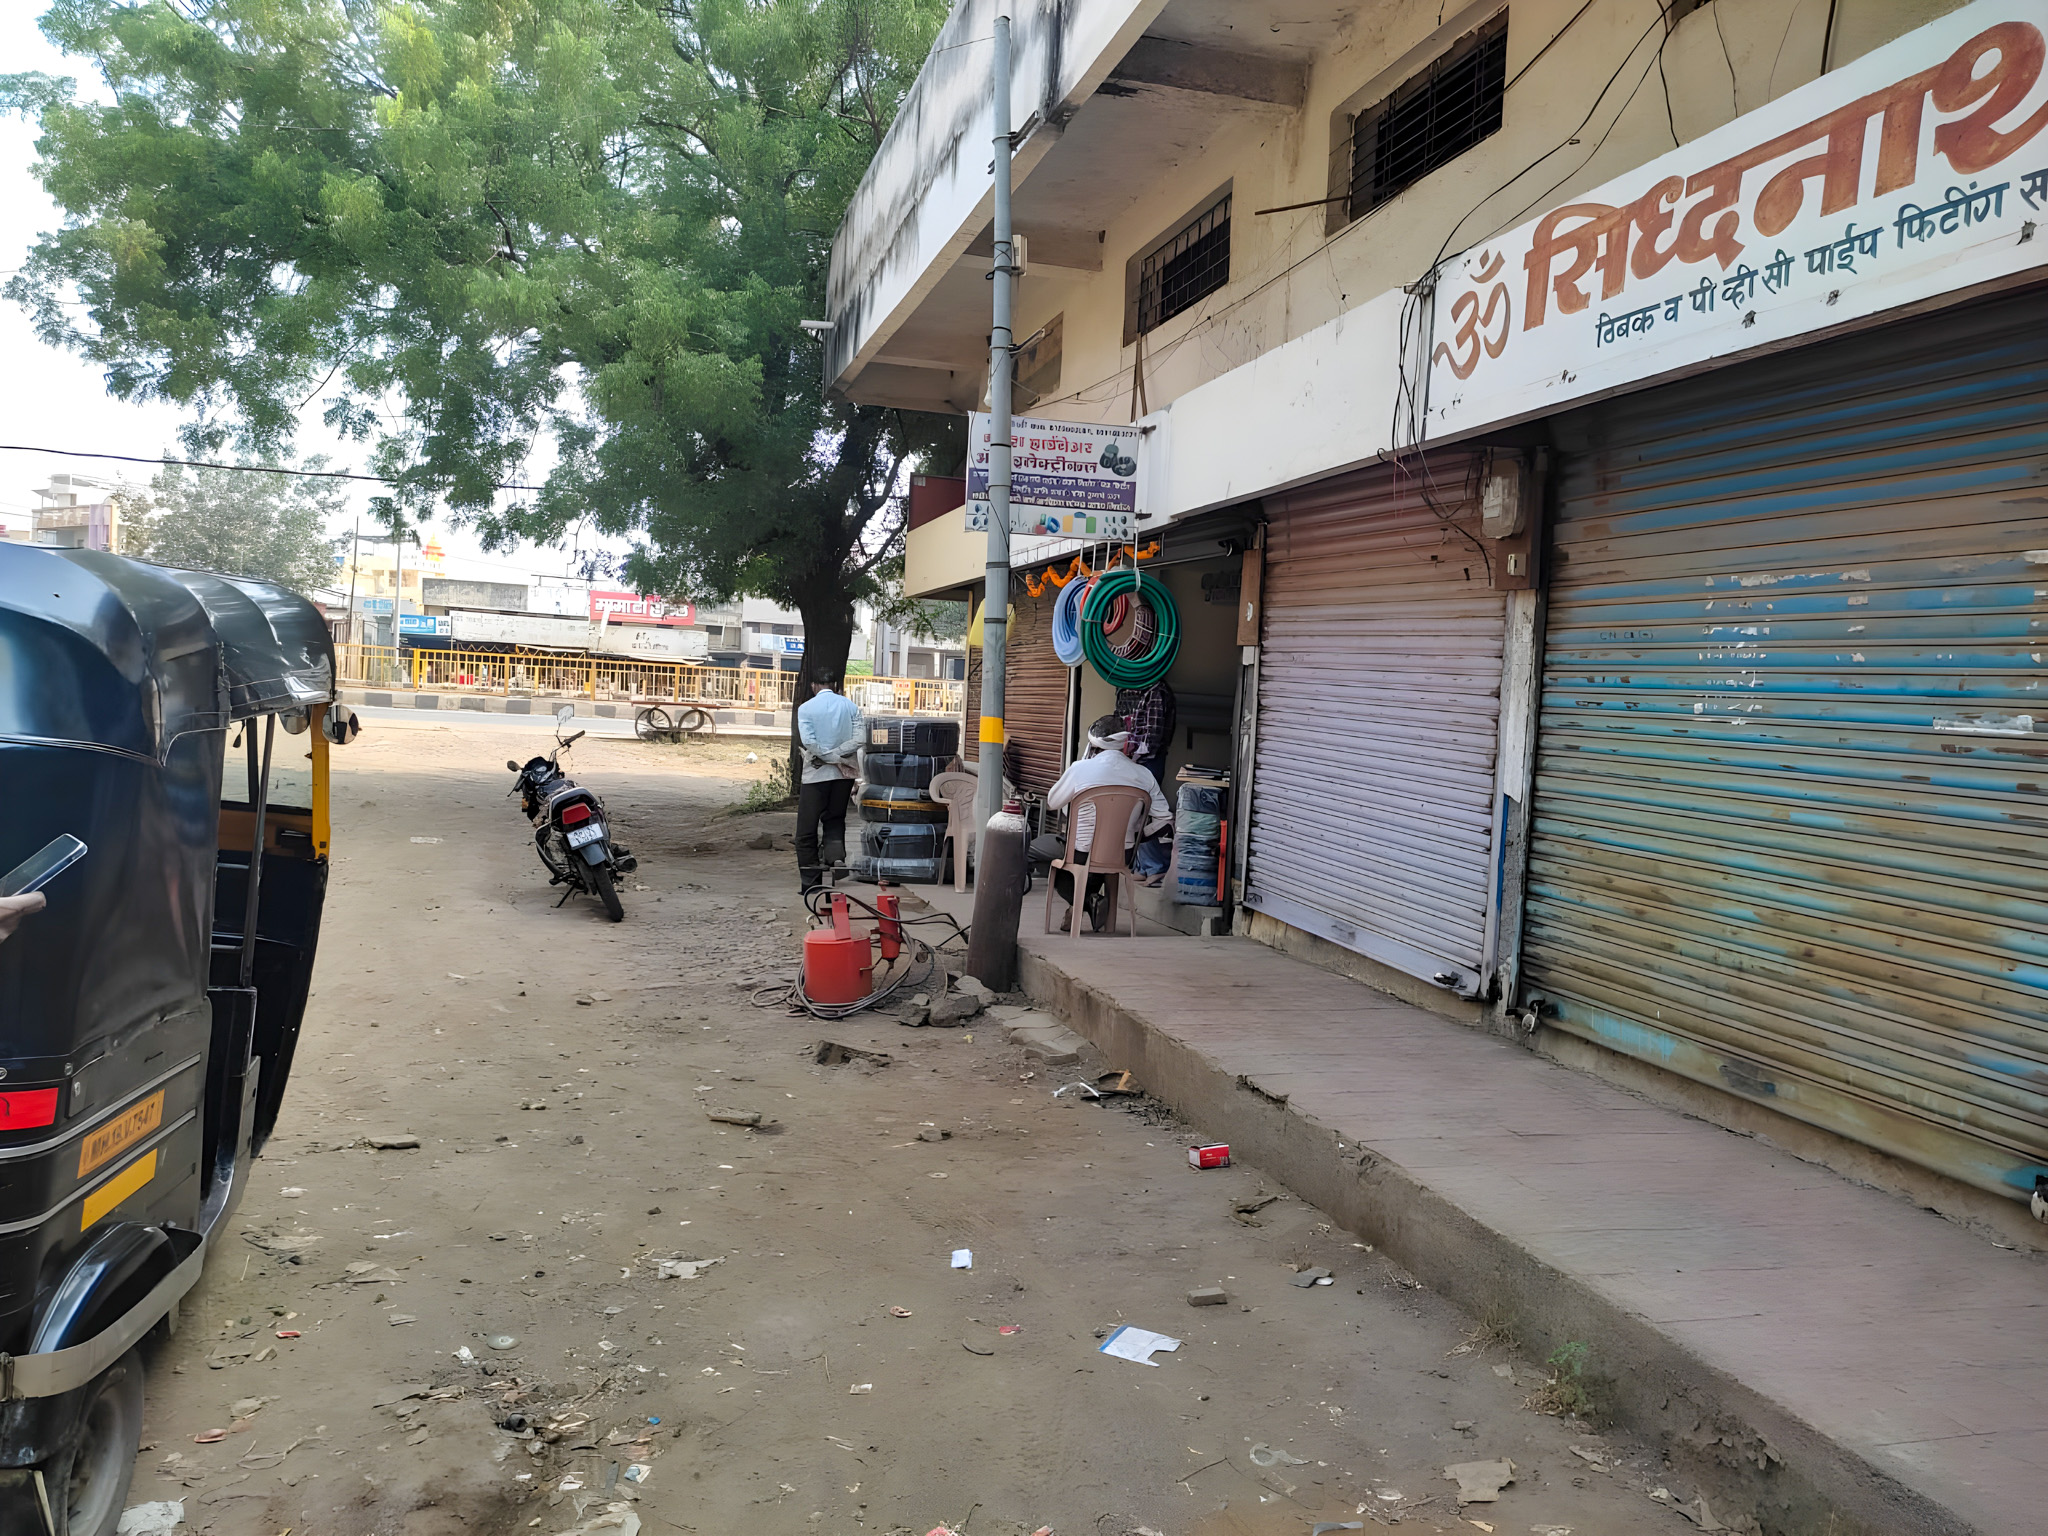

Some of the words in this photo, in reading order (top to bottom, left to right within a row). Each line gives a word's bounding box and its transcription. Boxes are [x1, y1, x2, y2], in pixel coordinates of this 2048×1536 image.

[1664, 295, 1683, 322] व
[1688, 275, 1718, 314] पी
[1761, 248, 1796, 295] सी
[1804, 222, 1885, 275] पाईप
[1893, 181, 2011, 249] फिटींग
